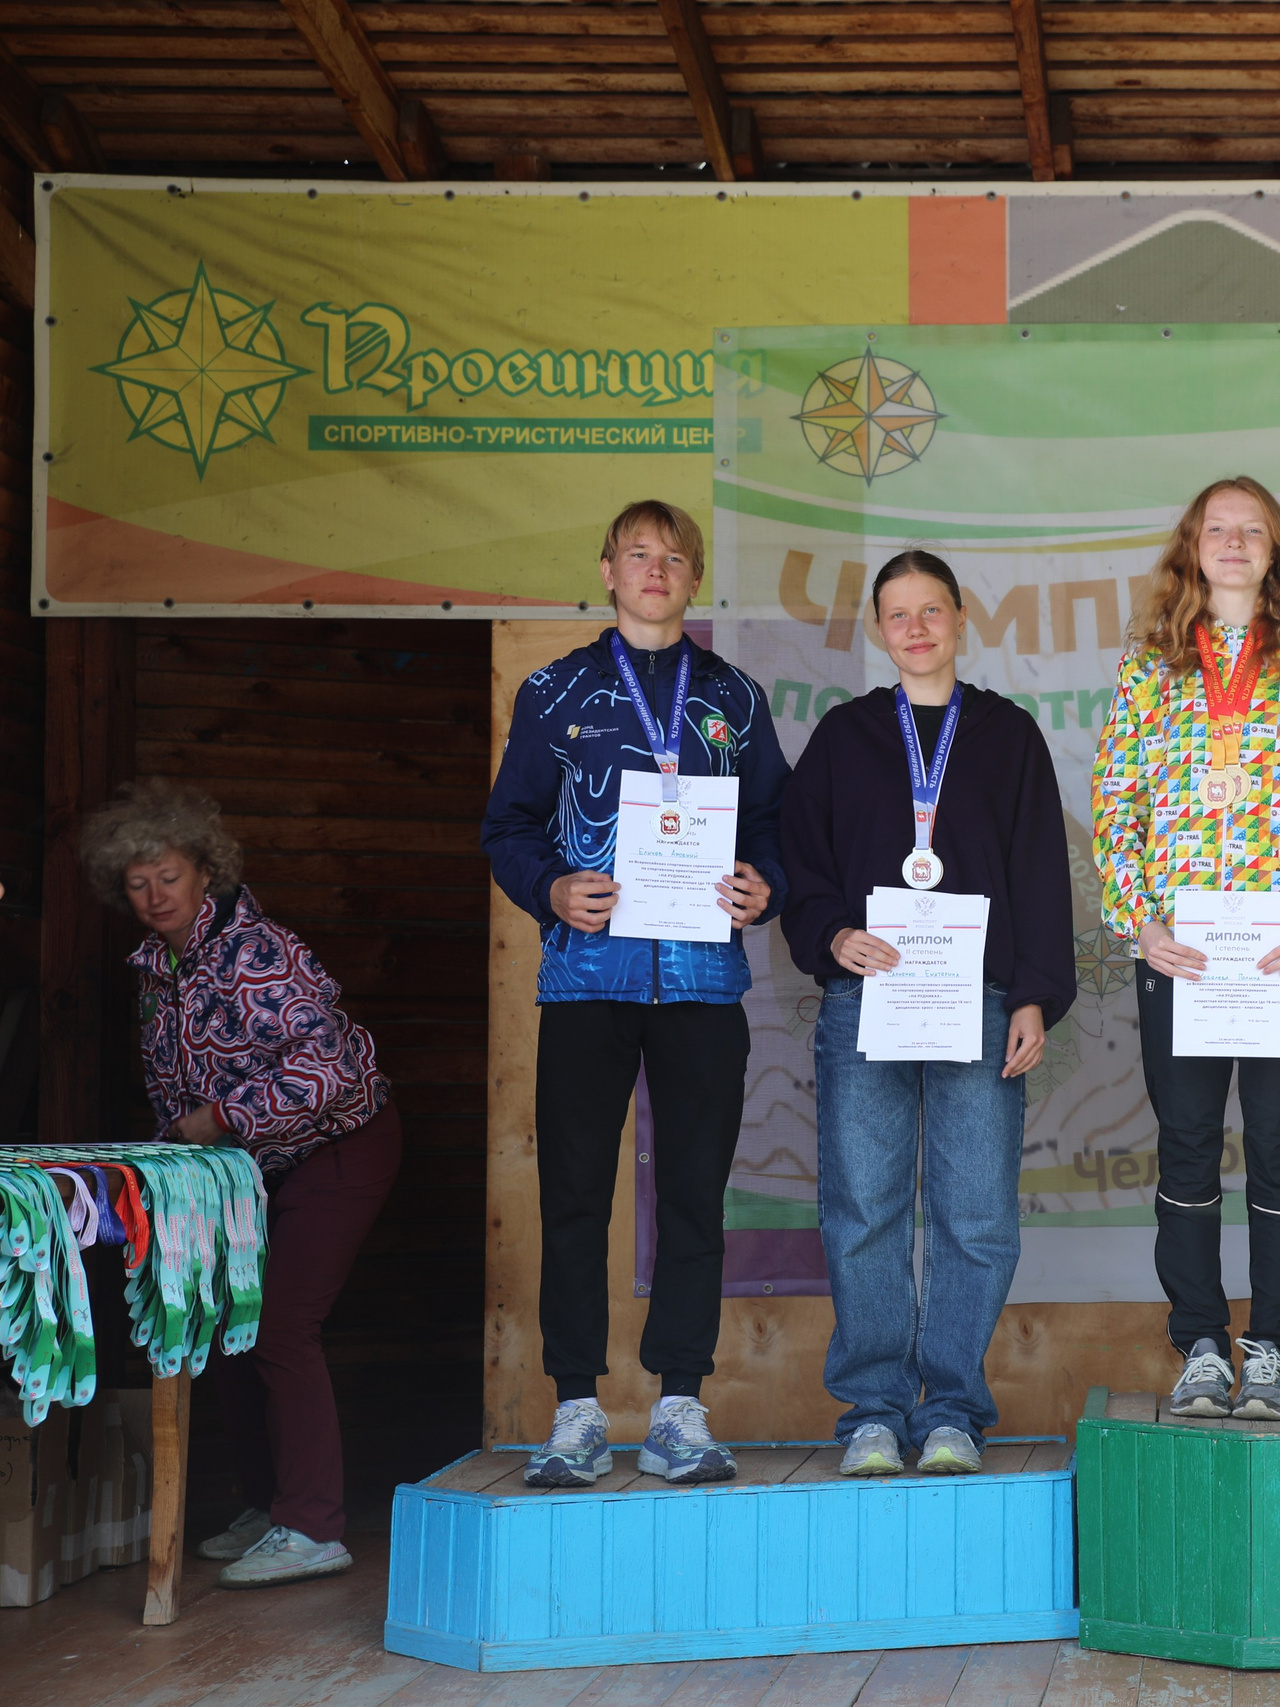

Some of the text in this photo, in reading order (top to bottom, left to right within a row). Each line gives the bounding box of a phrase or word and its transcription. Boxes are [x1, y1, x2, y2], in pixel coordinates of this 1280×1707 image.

[323, 421, 667, 447] СПОРТИВНО-ТУРИСТИЧЕСКИЙ
[617, 654, 657, 741] ЧЕЛЯБИНСКАЯ ОБЛАСТЬ
[670, 653, 689, 740] ЧЕЛЯБИНСКАЯ ОБЛАСТЬ
[900, 703, 921, 788] ЧЕЛЯБИНСКАЯ ОБЛАСТЬ
[929, 705, 958, 789] ЧЕЛЯБИНСКАЯ ОБЛАСТЬ
[896, 935, 953, 946] ДИПЛОМ
[1205, 932, 1262, 943] ДИПЛОМ
